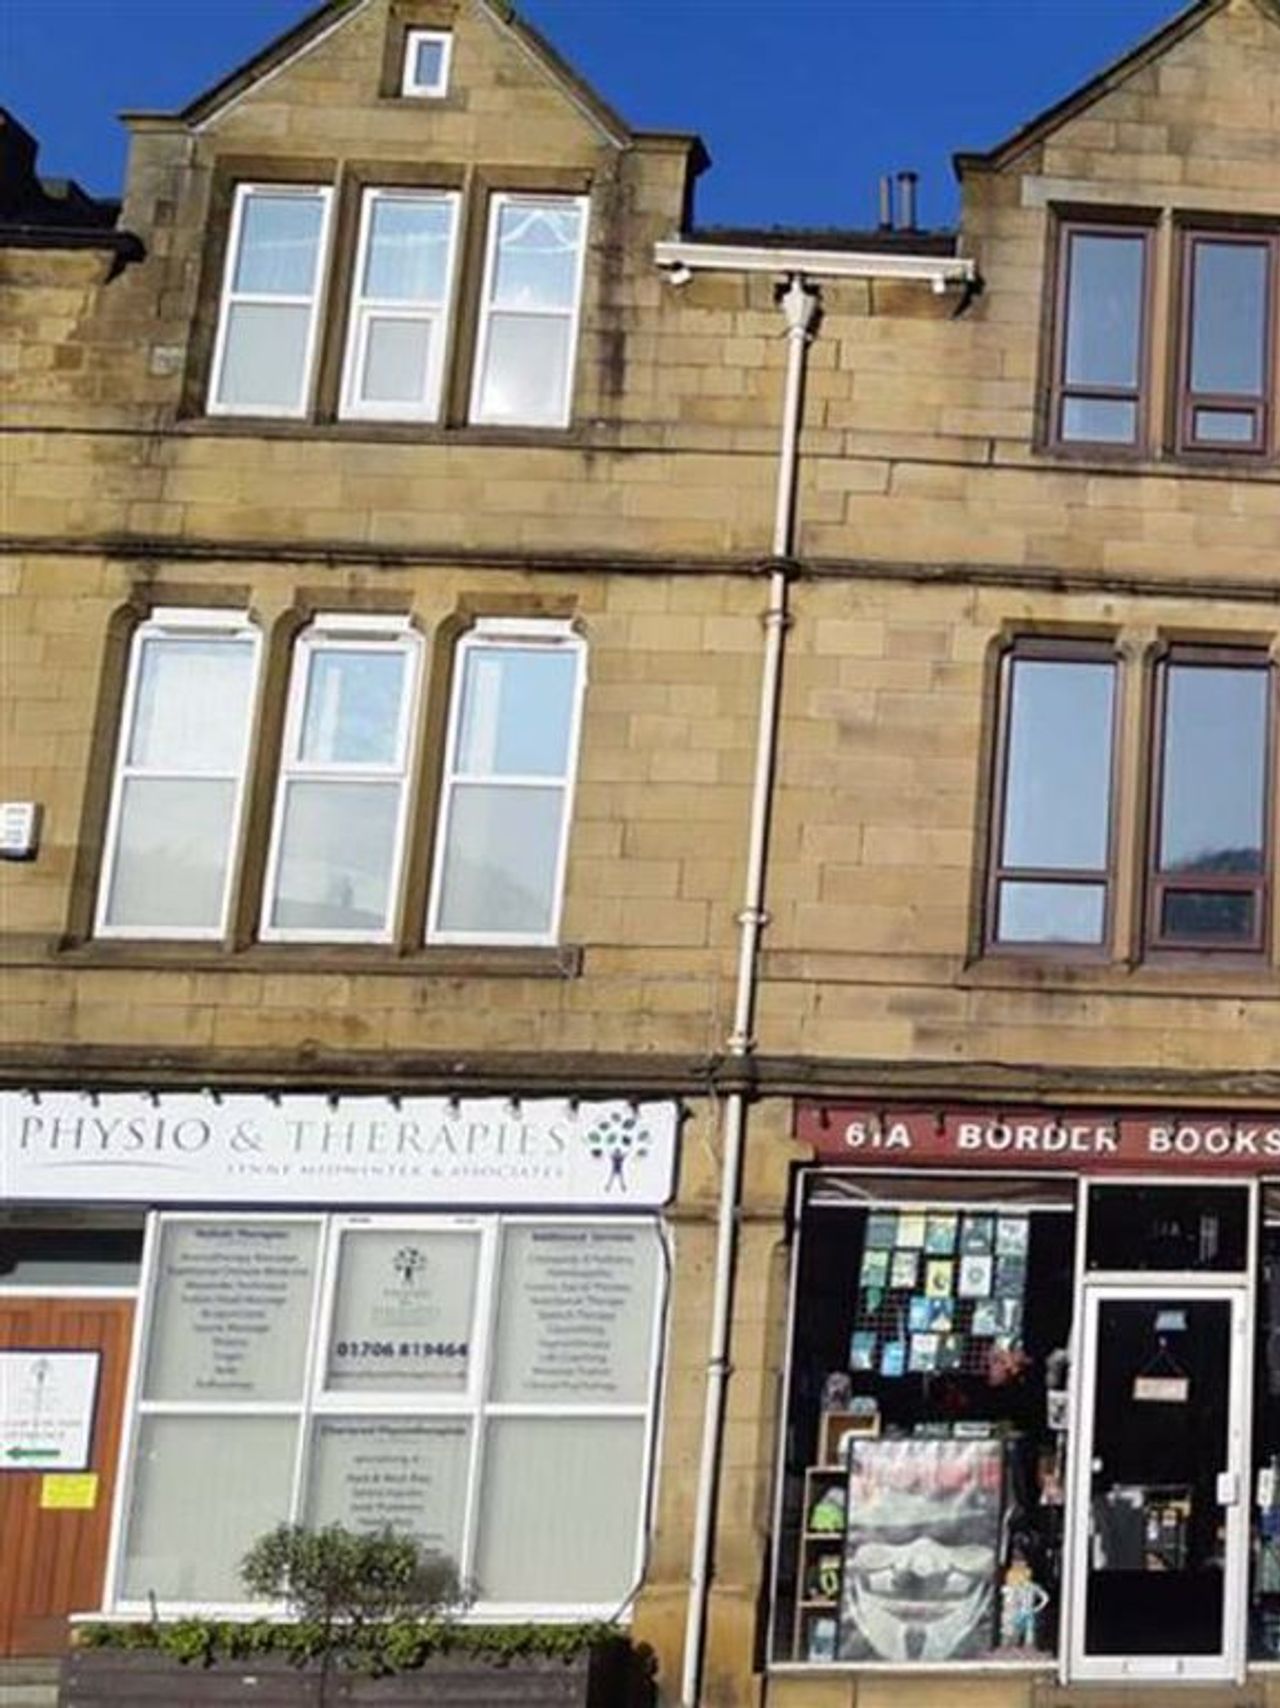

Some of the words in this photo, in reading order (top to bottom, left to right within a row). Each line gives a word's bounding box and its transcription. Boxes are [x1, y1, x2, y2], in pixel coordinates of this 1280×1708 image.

[20, 1115, 211, 1151] PHYSIO
[230, 1120, 264, 1151] &
[286, 1119, 567, 1153] THERAPIES
[844, 1121, 912, 1149] 61A
[957, 1123, 1119, 1152] BORDER
[336, 1340, 395, 1358] 01706
